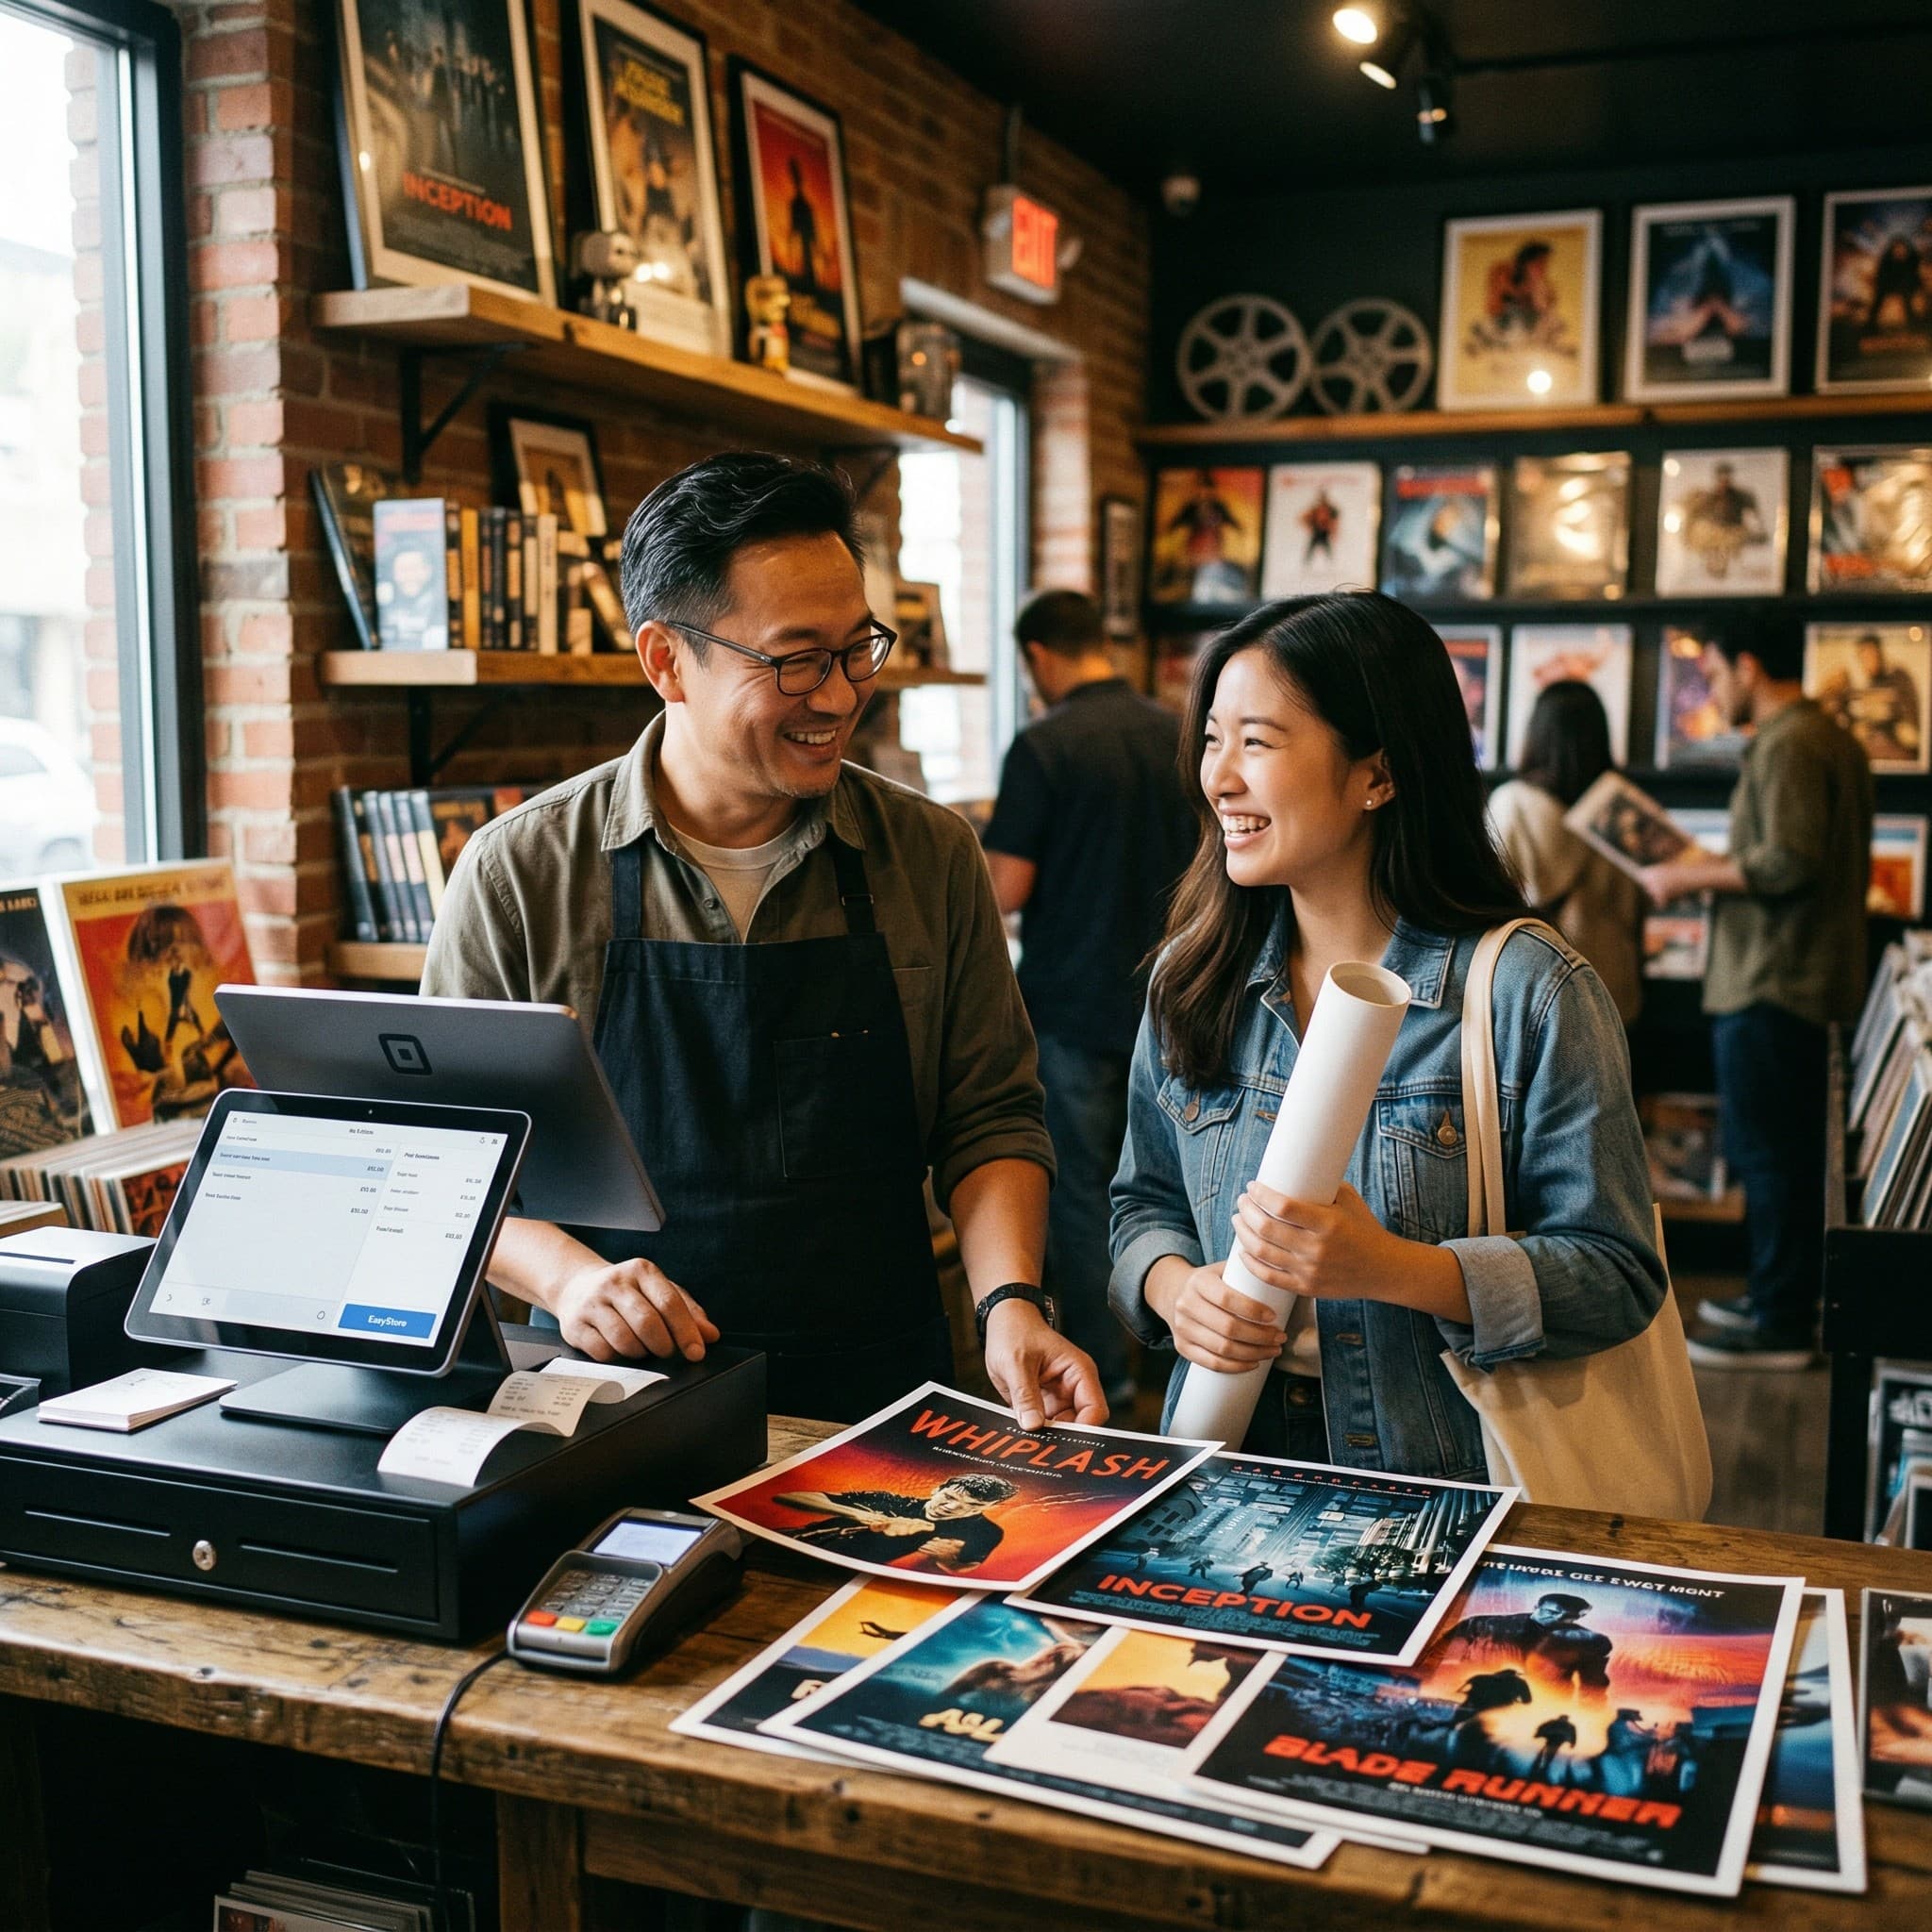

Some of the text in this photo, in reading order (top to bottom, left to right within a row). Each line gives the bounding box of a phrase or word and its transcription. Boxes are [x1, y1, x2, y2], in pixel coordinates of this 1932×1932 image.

[403, 170, 512, 231] INCEPTION
[368, 1314, 408, 1327] EasyStore
[910, 1409, 1170, 1480] WHIPLASH
[1097, 1574, 1373, 1629] INCEPTION
[1263, 1734, 1438, 1785] BLADE
[1441, 1768, 1683, 1829] RUNNER
